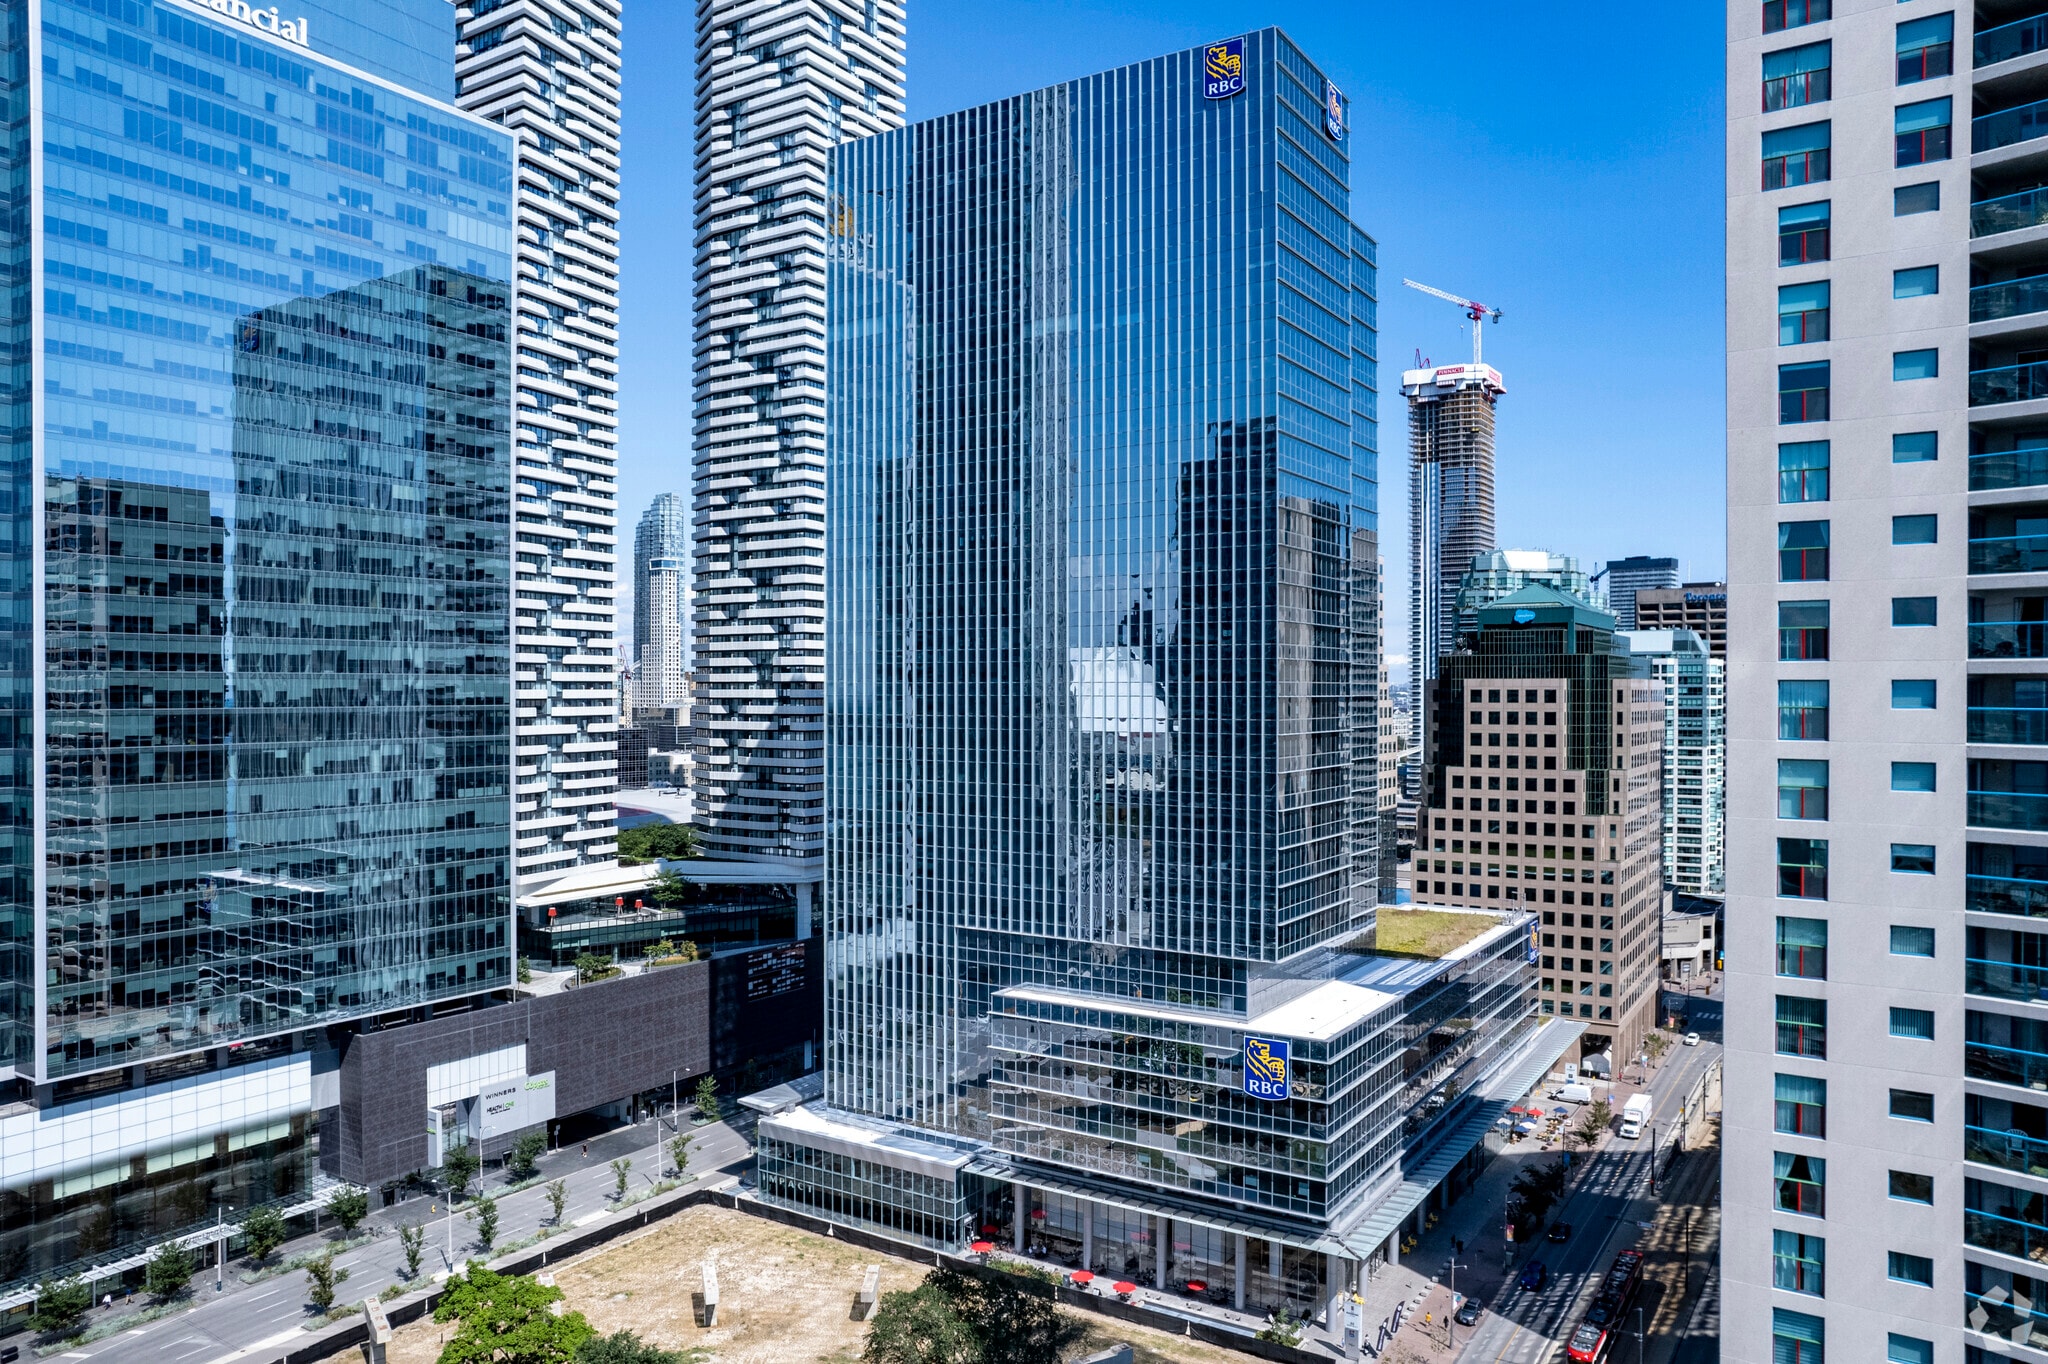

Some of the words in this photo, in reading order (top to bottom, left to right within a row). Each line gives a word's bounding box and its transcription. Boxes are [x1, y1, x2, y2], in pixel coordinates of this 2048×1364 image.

[194, 0, 309, 47] ancial
[1208, 77, 1240, 95] RBC
[1329, 117, 1341, 137] RBC
[485, 1087, 516, 1100] WINNERS
[1249, 1079, 1284, 1096] RBC
[762, 1172, 813, 1193] IMPACT
